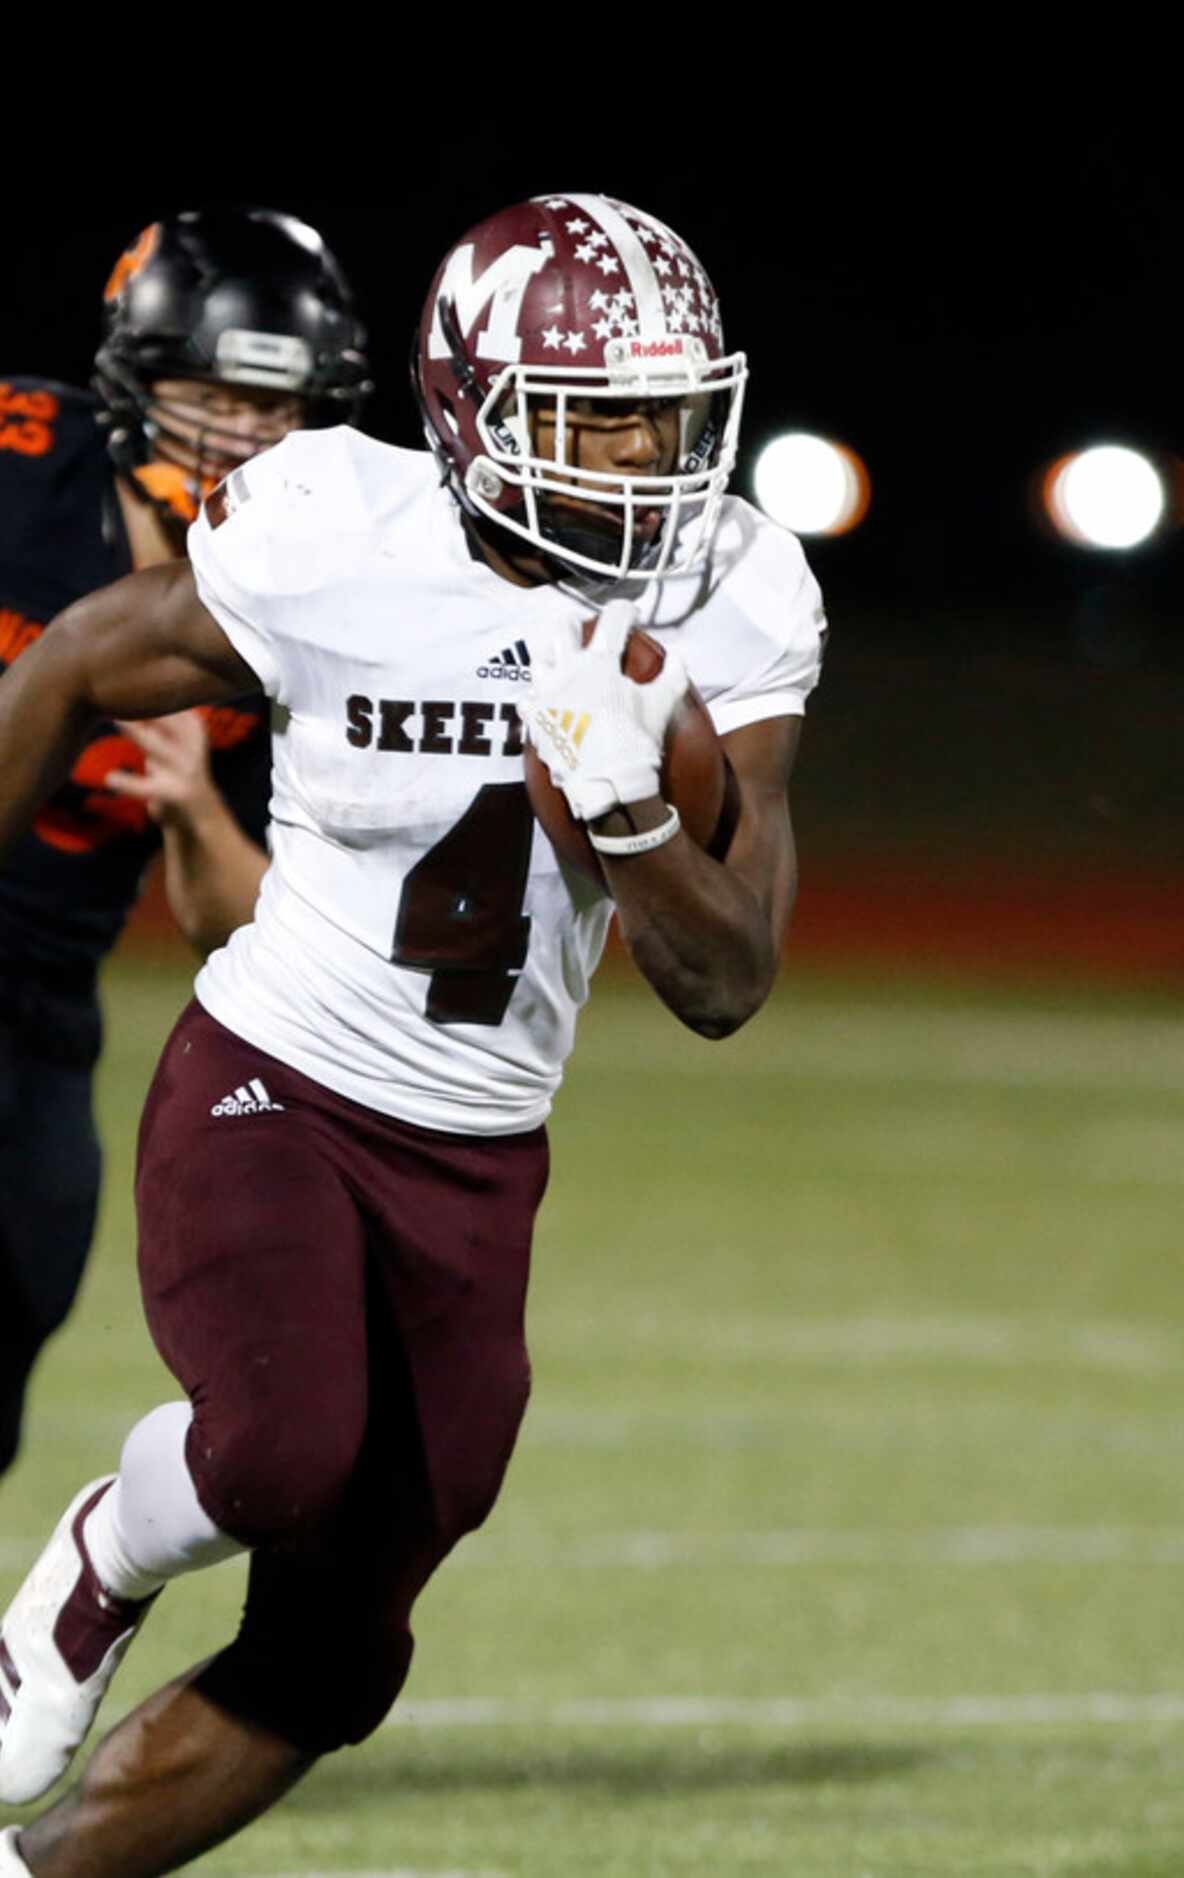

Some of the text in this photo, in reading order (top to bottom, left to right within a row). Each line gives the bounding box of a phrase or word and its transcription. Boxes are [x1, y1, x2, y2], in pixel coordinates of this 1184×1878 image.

[427, 232, 555, 365] M
[630, 338, 684, 357] Riddell
[391, 781, 535, 1027] 4
